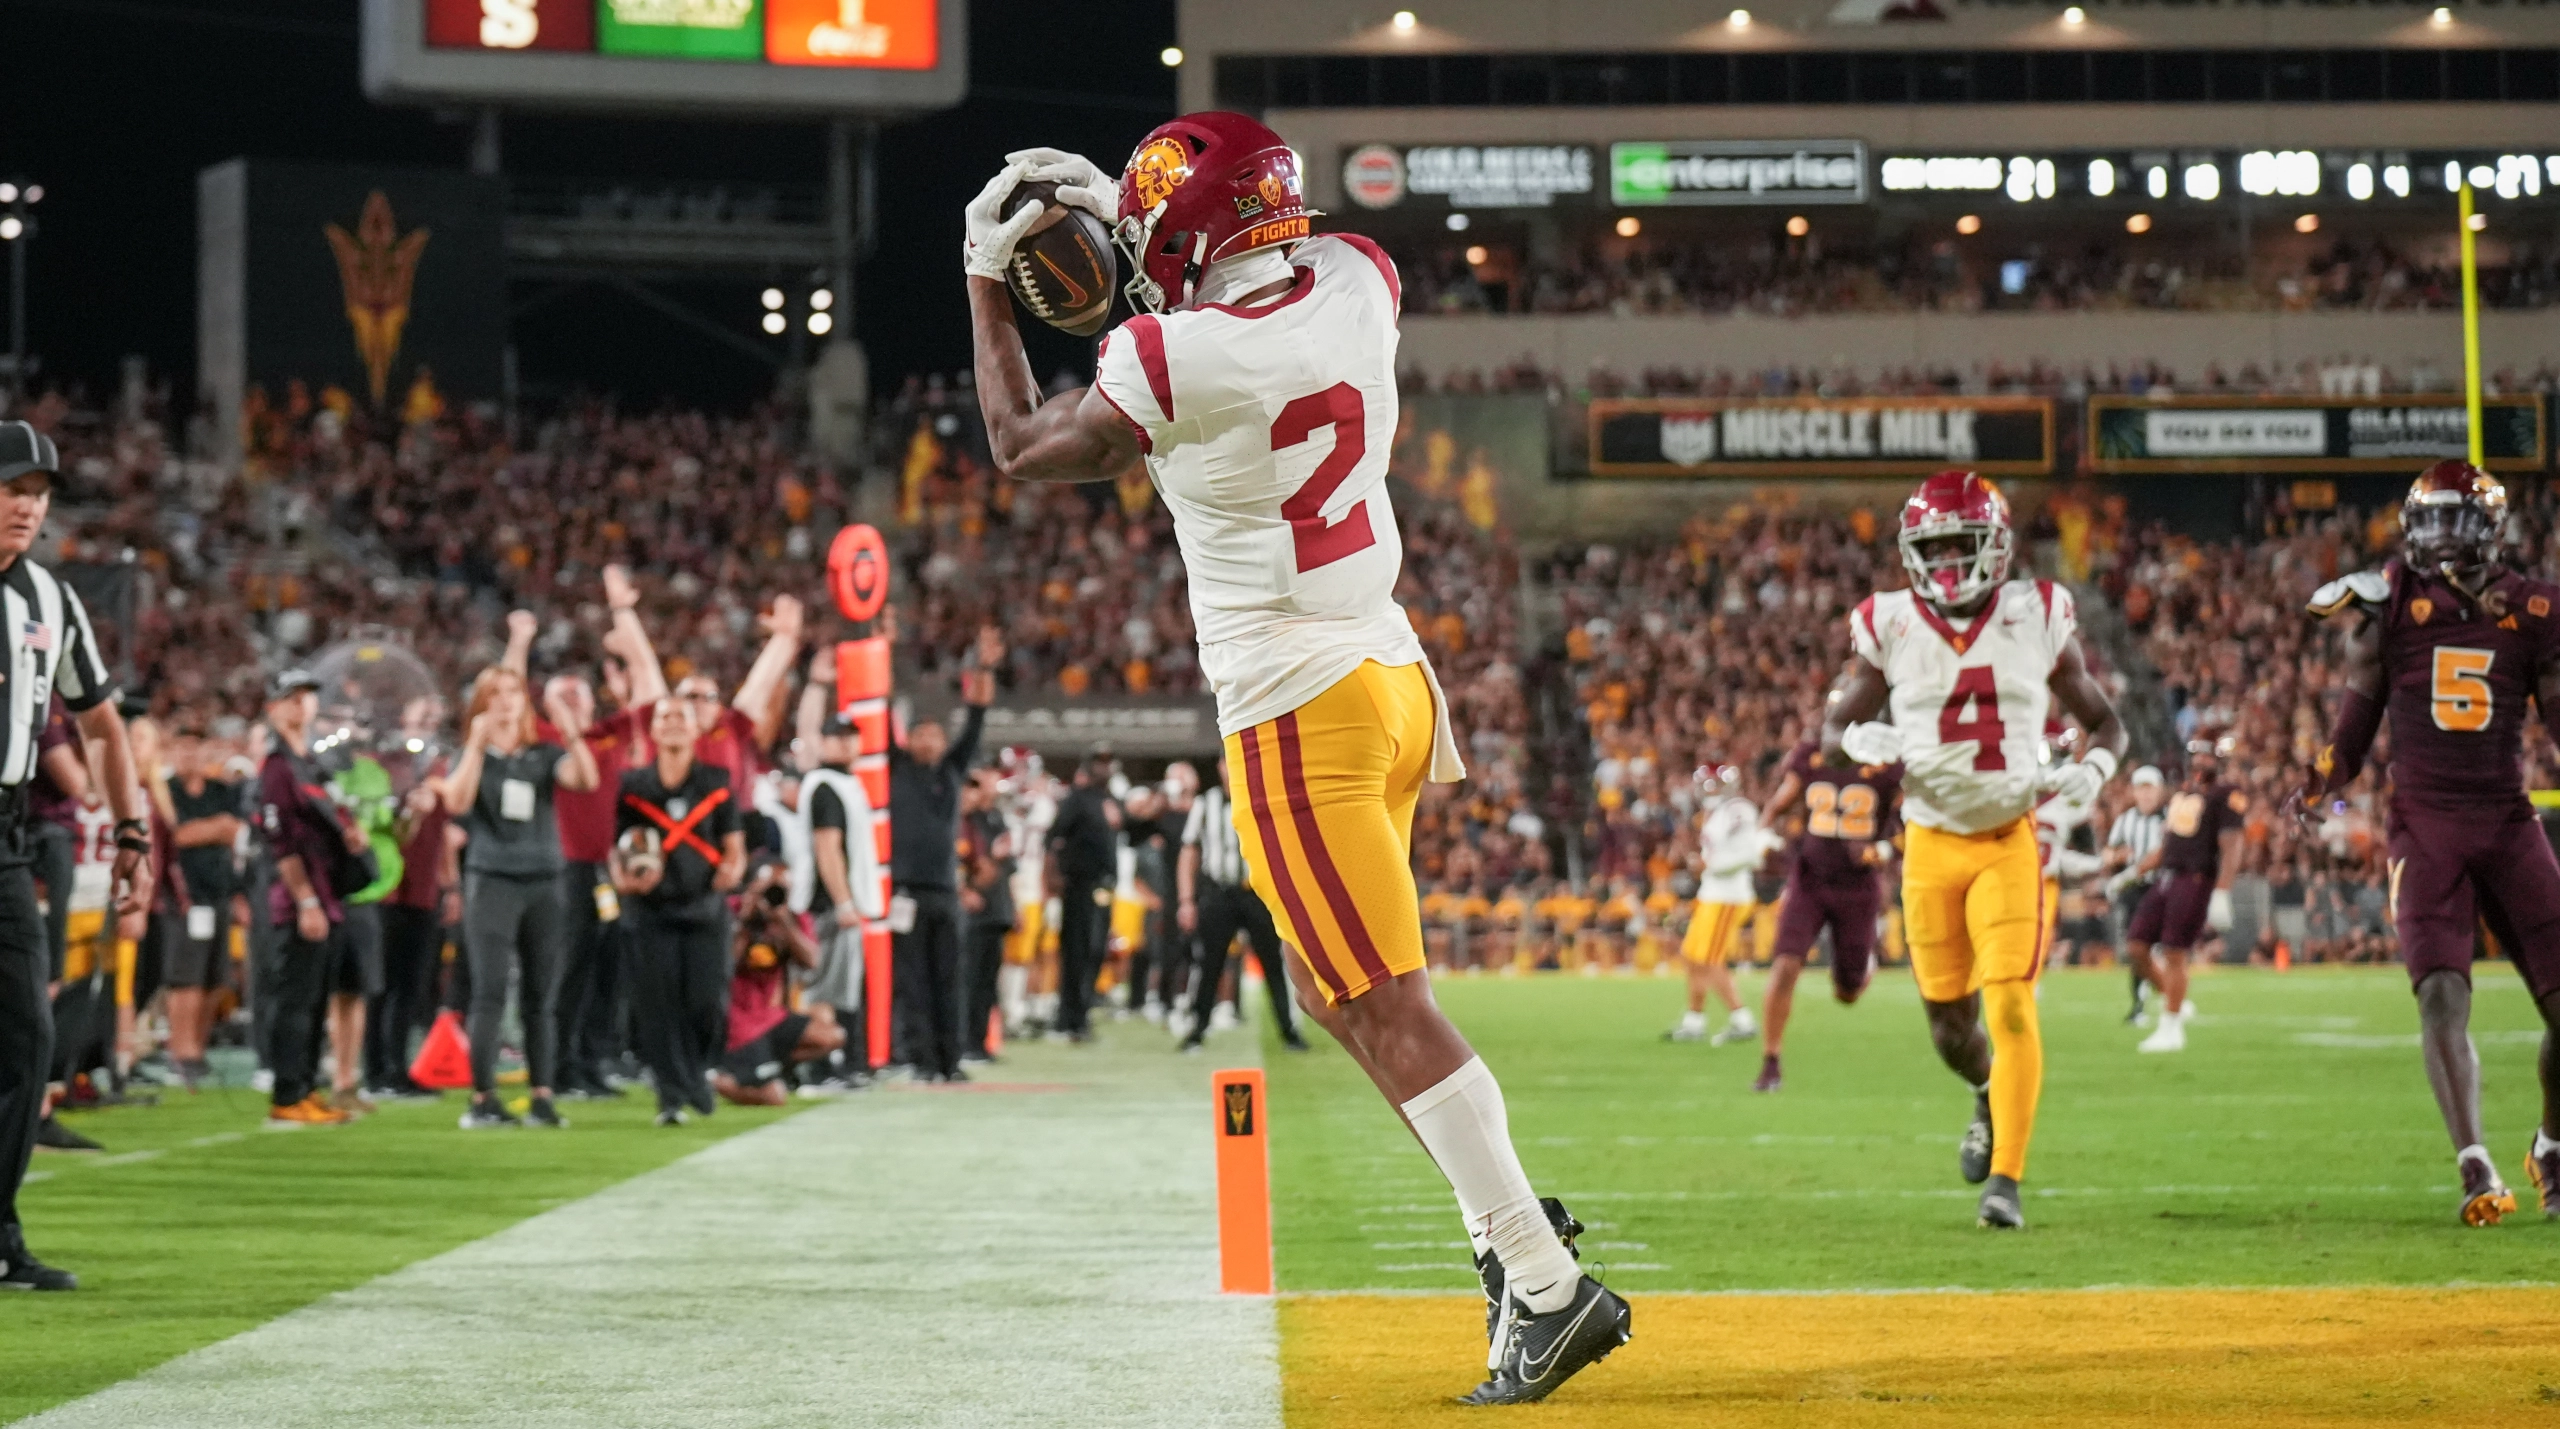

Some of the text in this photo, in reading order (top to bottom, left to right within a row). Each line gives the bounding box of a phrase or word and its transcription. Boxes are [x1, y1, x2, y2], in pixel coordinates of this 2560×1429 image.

[1629, 150, 1856, 195] enterprise
[1250, 220, 1297, 246] FIGHT
[1722, 408, 1872, 457] MUSCLE
[1880, 408, 1976, 460] MILK
[1271, 380, 1376, 574] 2
[1939, 664, 2006, 771] 4
[2431, 646, 2496, 731] 5
[1805, 781, 1879, 840] 22
